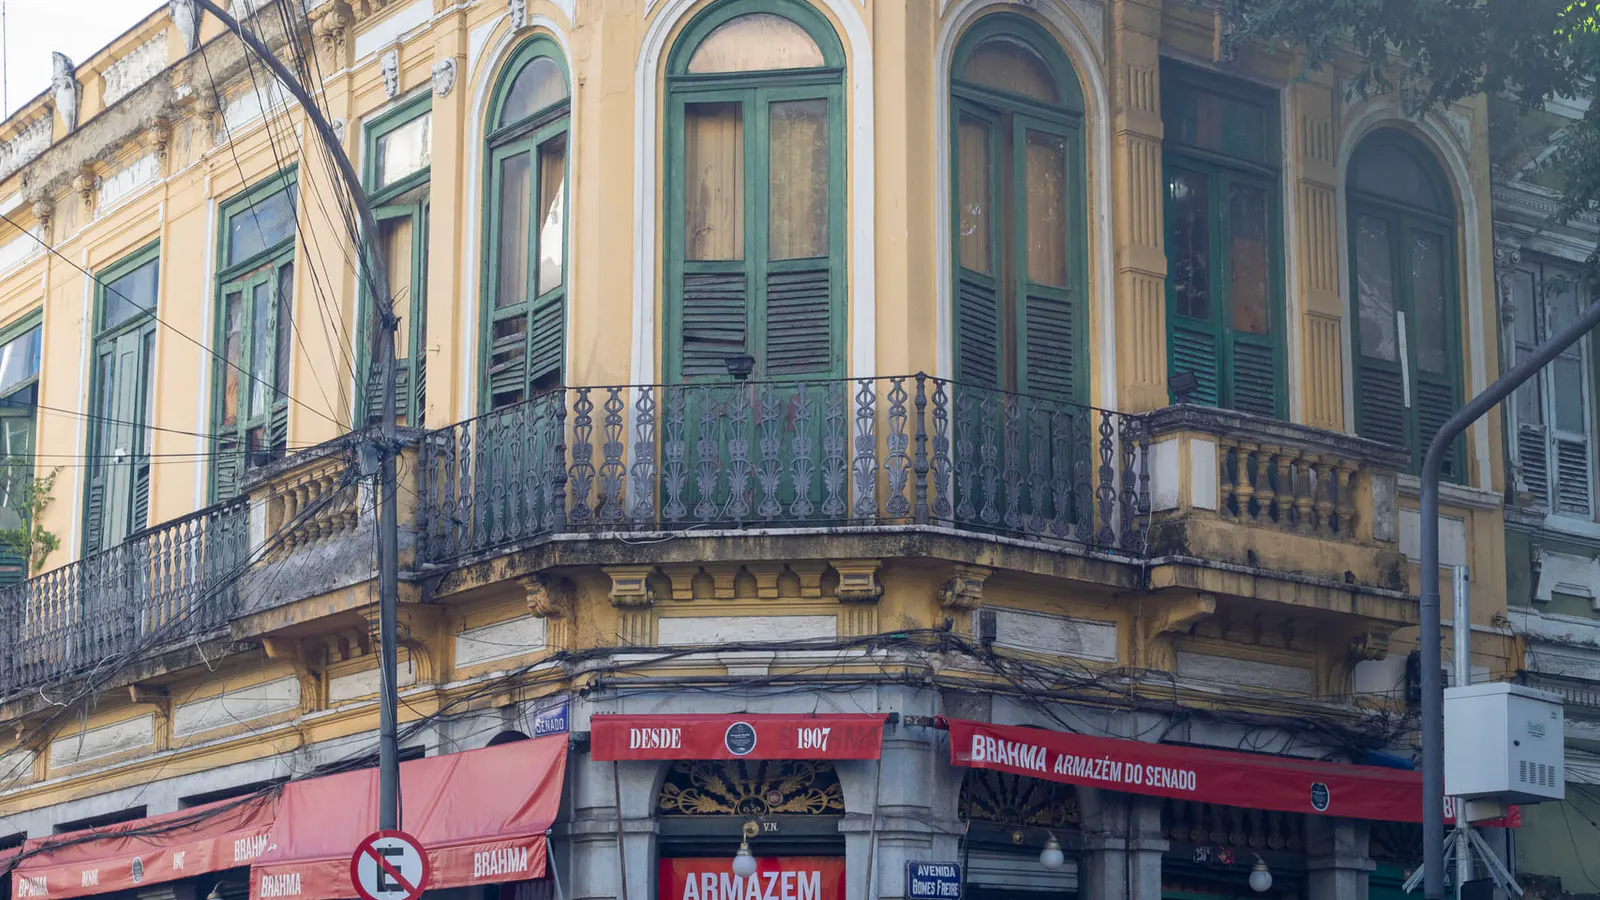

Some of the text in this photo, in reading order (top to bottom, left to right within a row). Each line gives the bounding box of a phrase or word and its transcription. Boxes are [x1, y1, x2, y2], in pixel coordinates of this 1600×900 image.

[535, 717, 565, 733] SENADO
[629, 727, 681, 749] DESDE
[796, 726, 831, 752] 1907
[971, 734, 1197, 791] BRAHMA ARMAZÉM DO SENADO
[376, 847, 404, 892] E
[474, 846, 528, 878] BRAHMA
[917, 864, 956, 878] AVENIDA
[260, 873, 302, 898] BRAHMA
[683, 871, 822, 900] ARMAZEM
